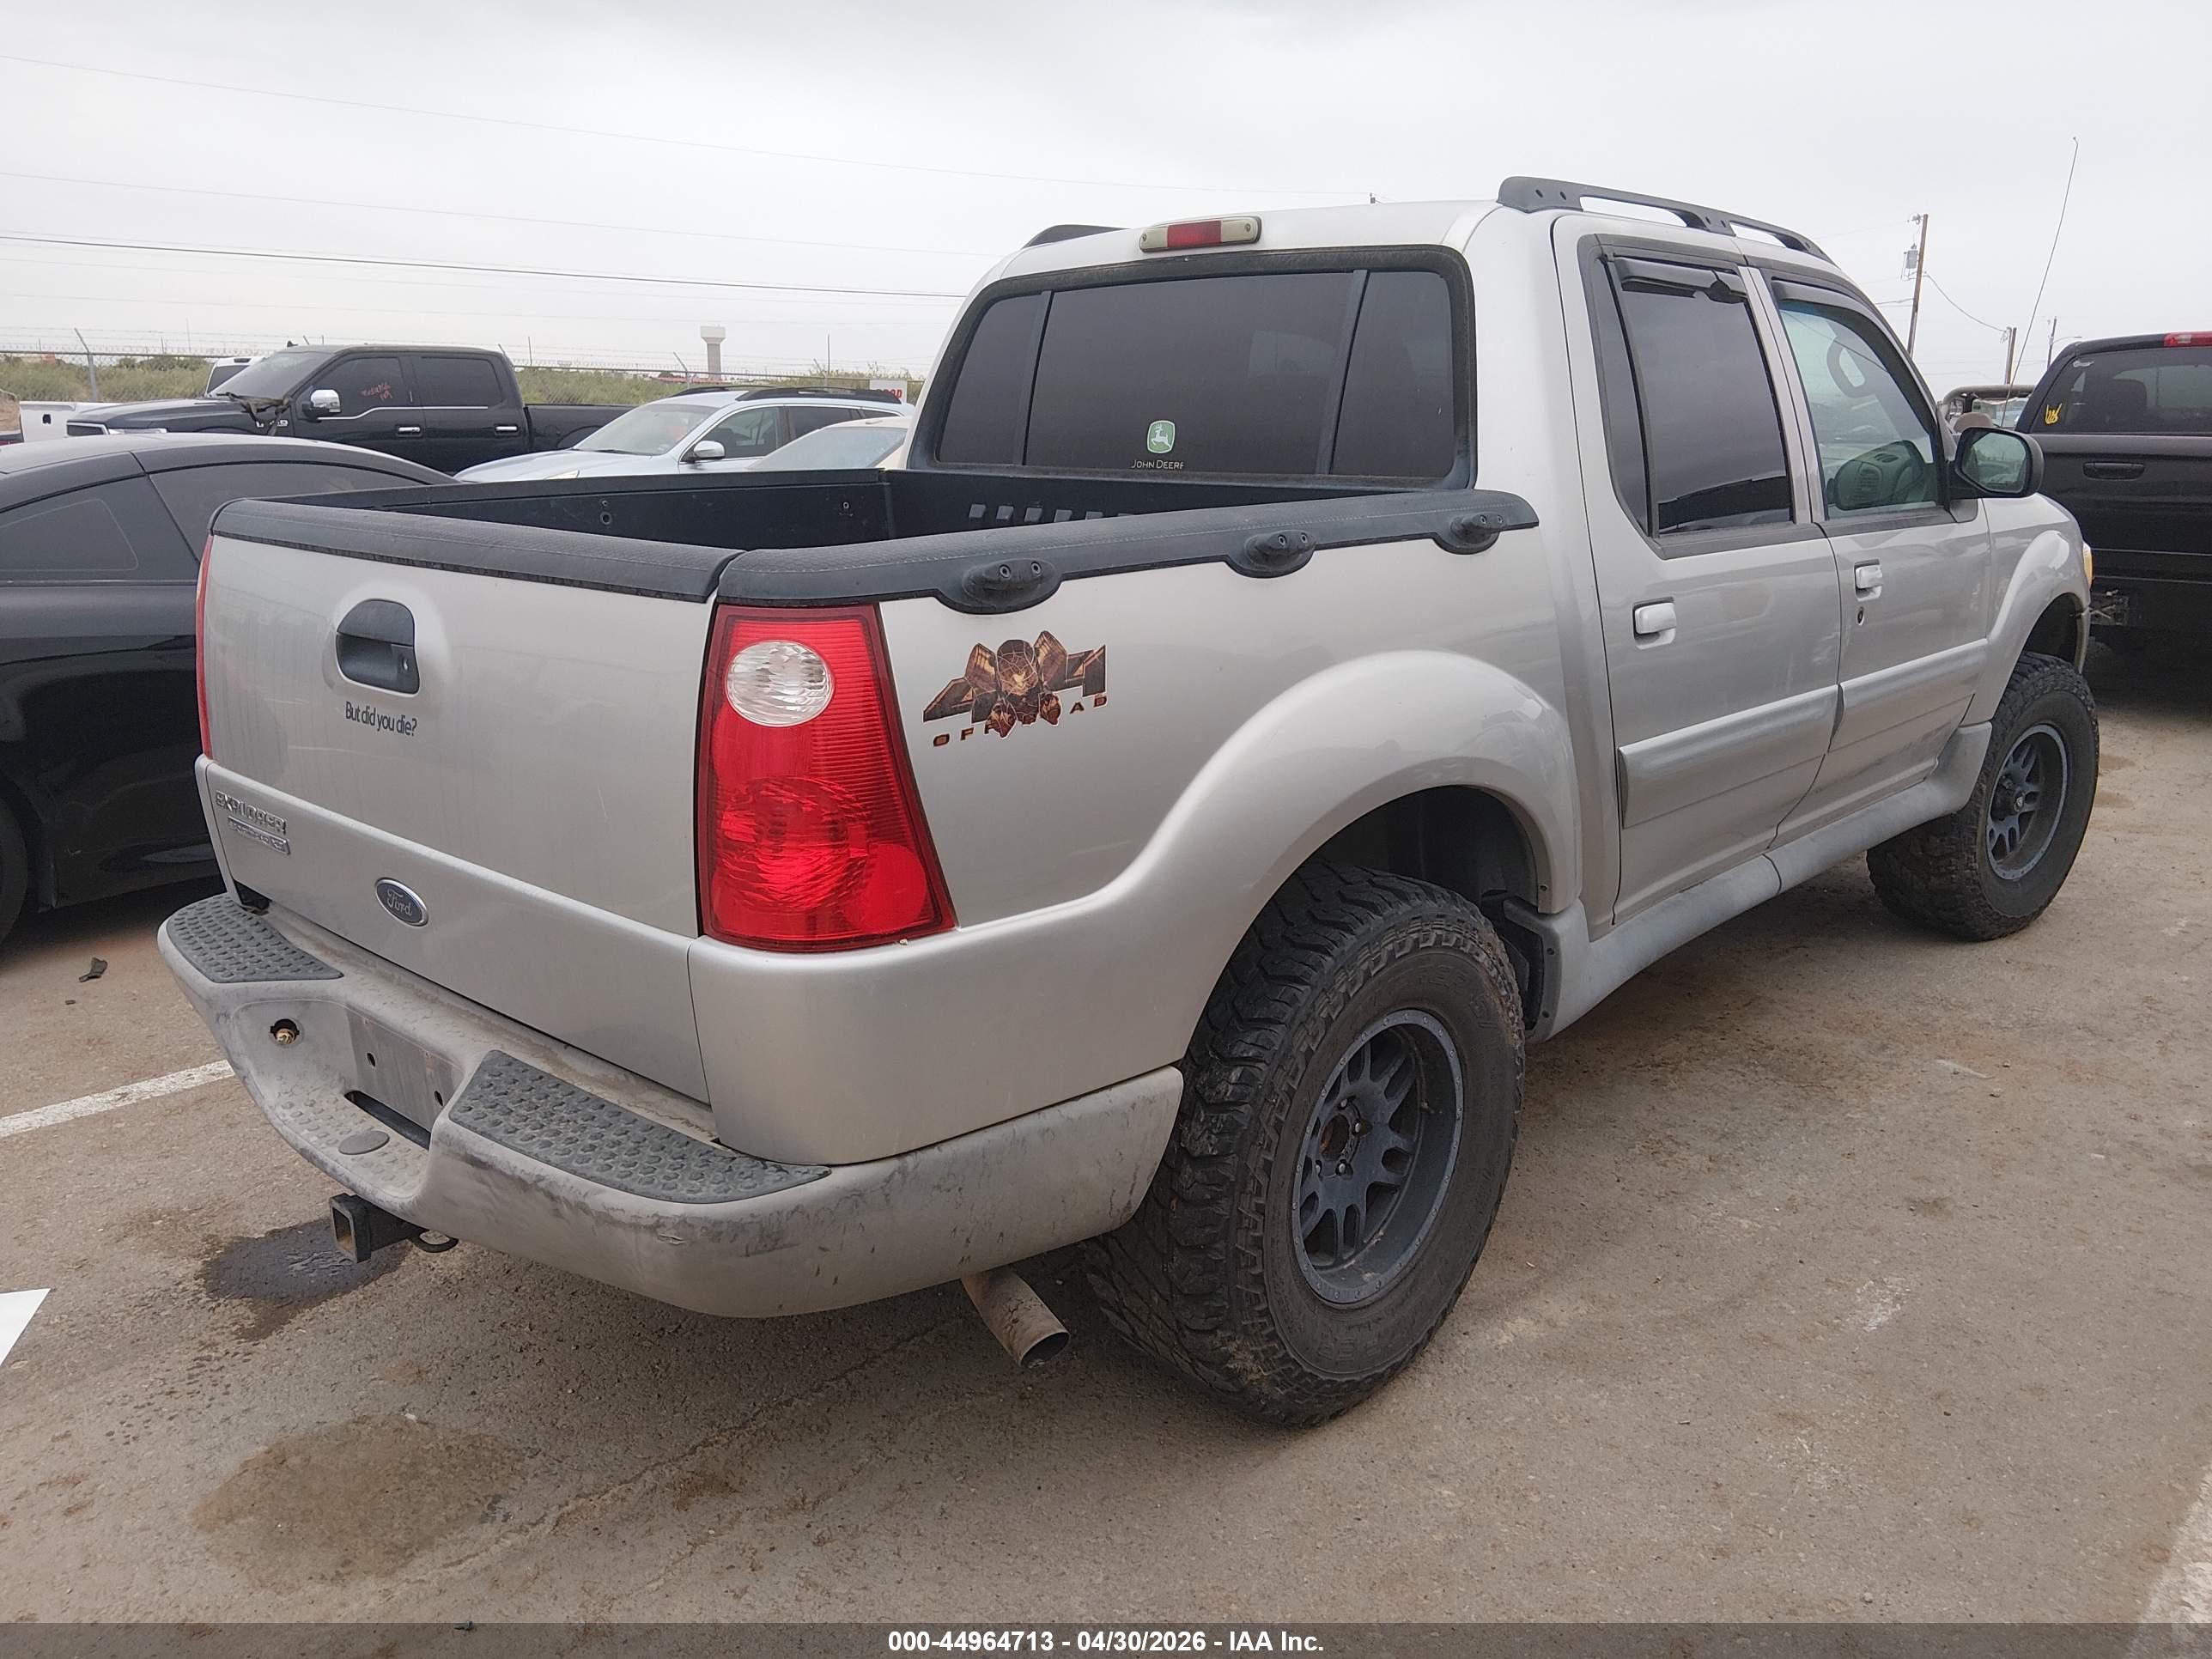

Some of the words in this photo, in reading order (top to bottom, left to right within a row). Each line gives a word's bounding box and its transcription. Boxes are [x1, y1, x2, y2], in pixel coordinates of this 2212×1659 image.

[1131, 459, 1154, 469] JOHN
[345, 701, 360, 722] But
[362, 706, 376, 726] did
[377, 714, 394, 732] you
[396, 714, 417, 736] die?
